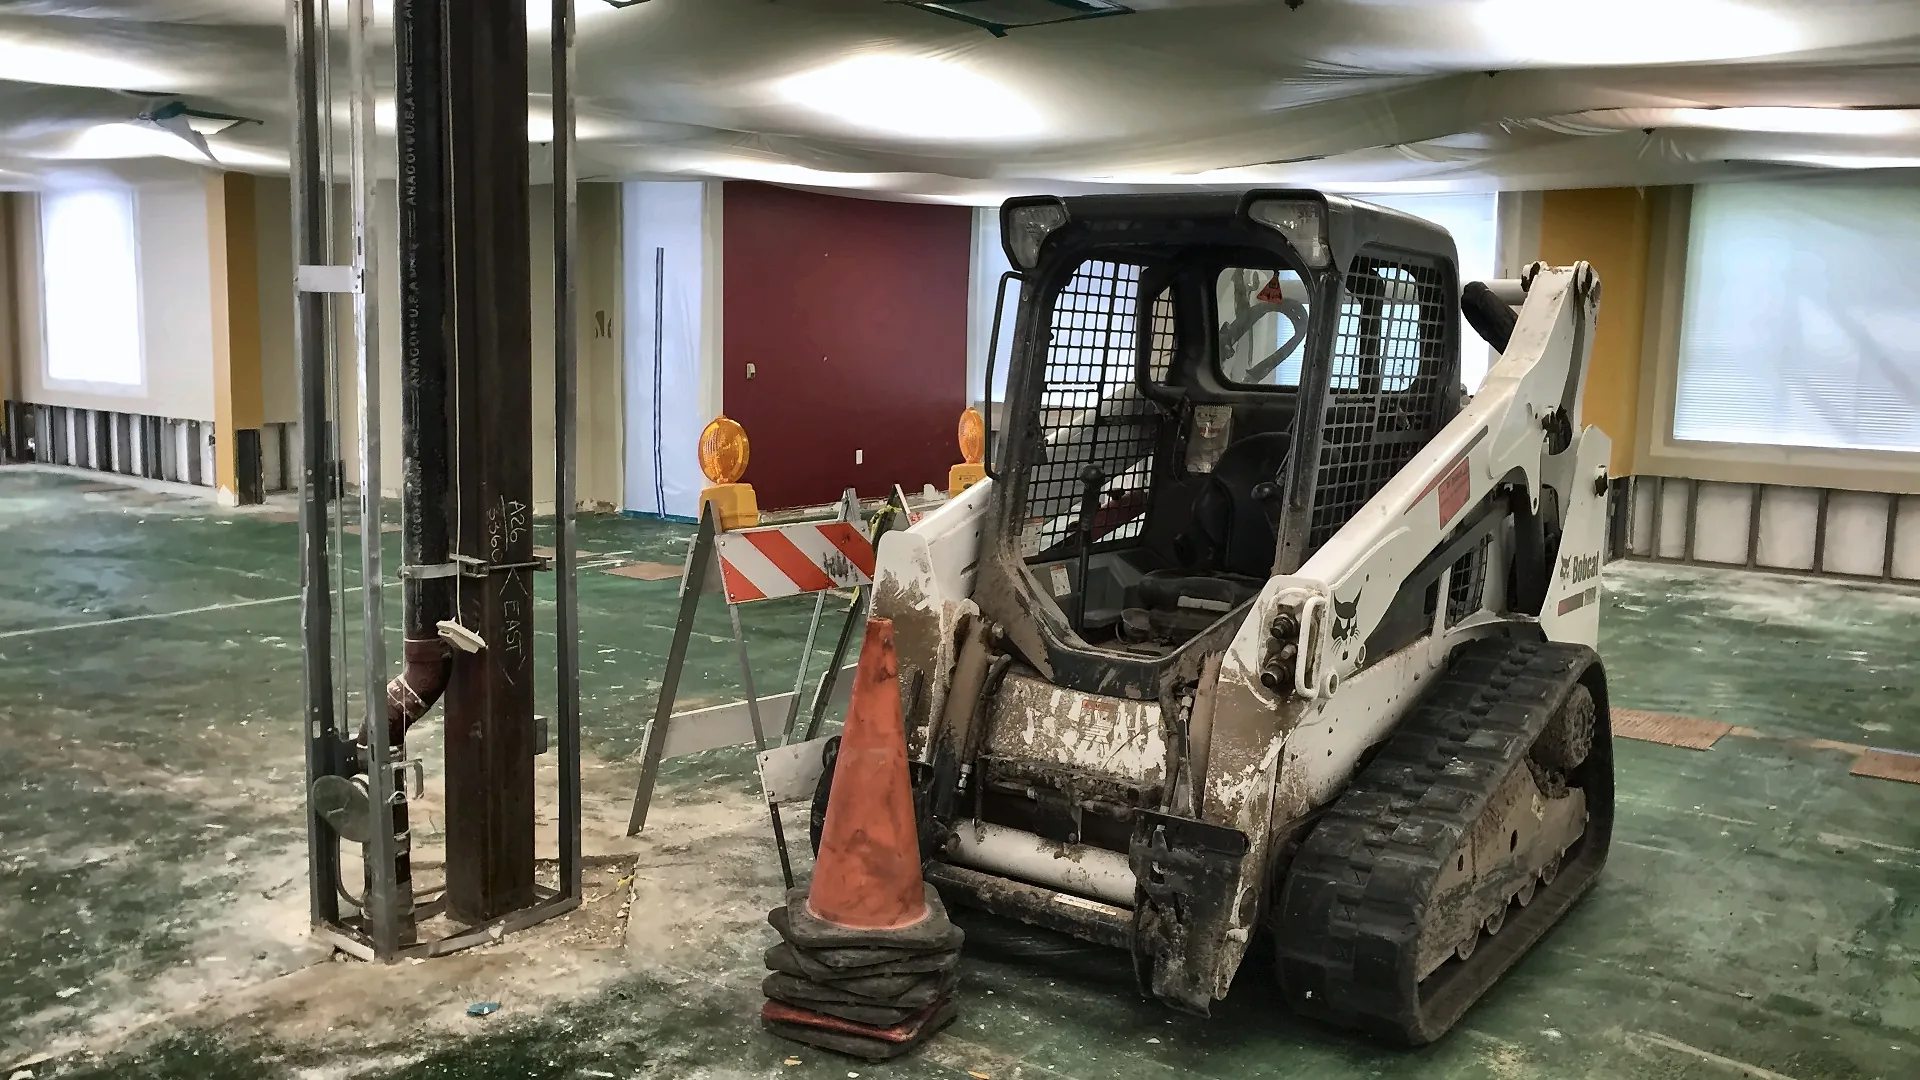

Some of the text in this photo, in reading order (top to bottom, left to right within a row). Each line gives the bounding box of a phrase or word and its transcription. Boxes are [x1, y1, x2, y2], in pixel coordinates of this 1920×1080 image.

[508, 500, 527, 543] A26
[1572, 550, 1599, 584] Bobcat
[504, 600, 522, 657] EAST
